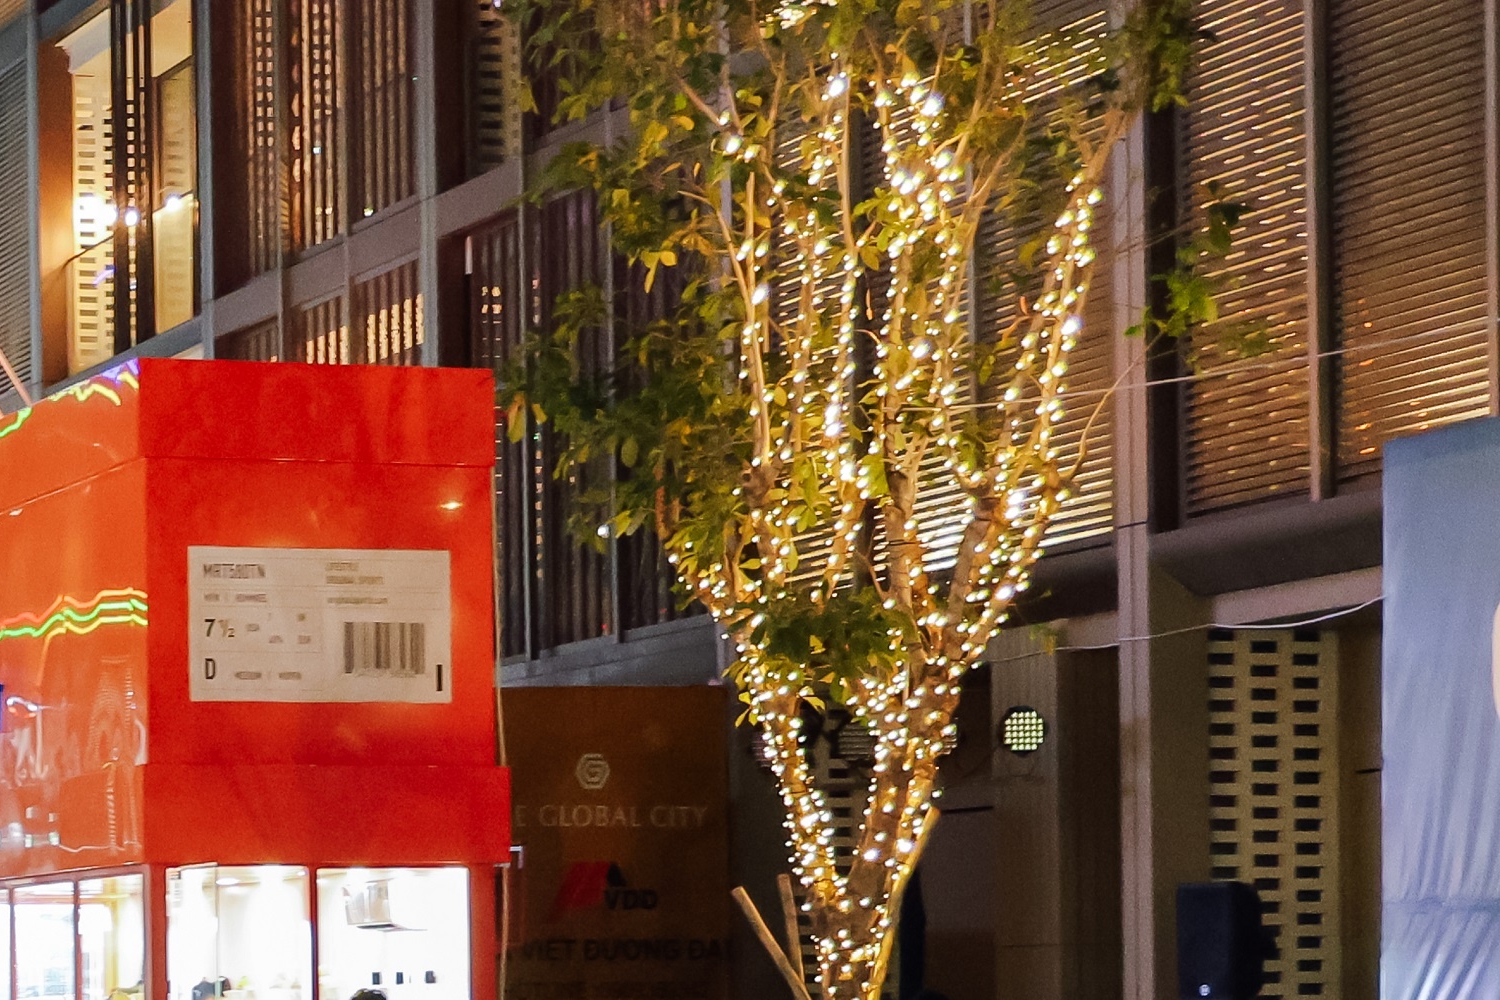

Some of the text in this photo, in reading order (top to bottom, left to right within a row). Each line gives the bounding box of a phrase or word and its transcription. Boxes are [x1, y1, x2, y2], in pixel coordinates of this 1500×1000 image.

[205, 658, 216, 680] D
[538, 804, 642, 828] GLOBAL
[650, 804, 709, 829] CITY
